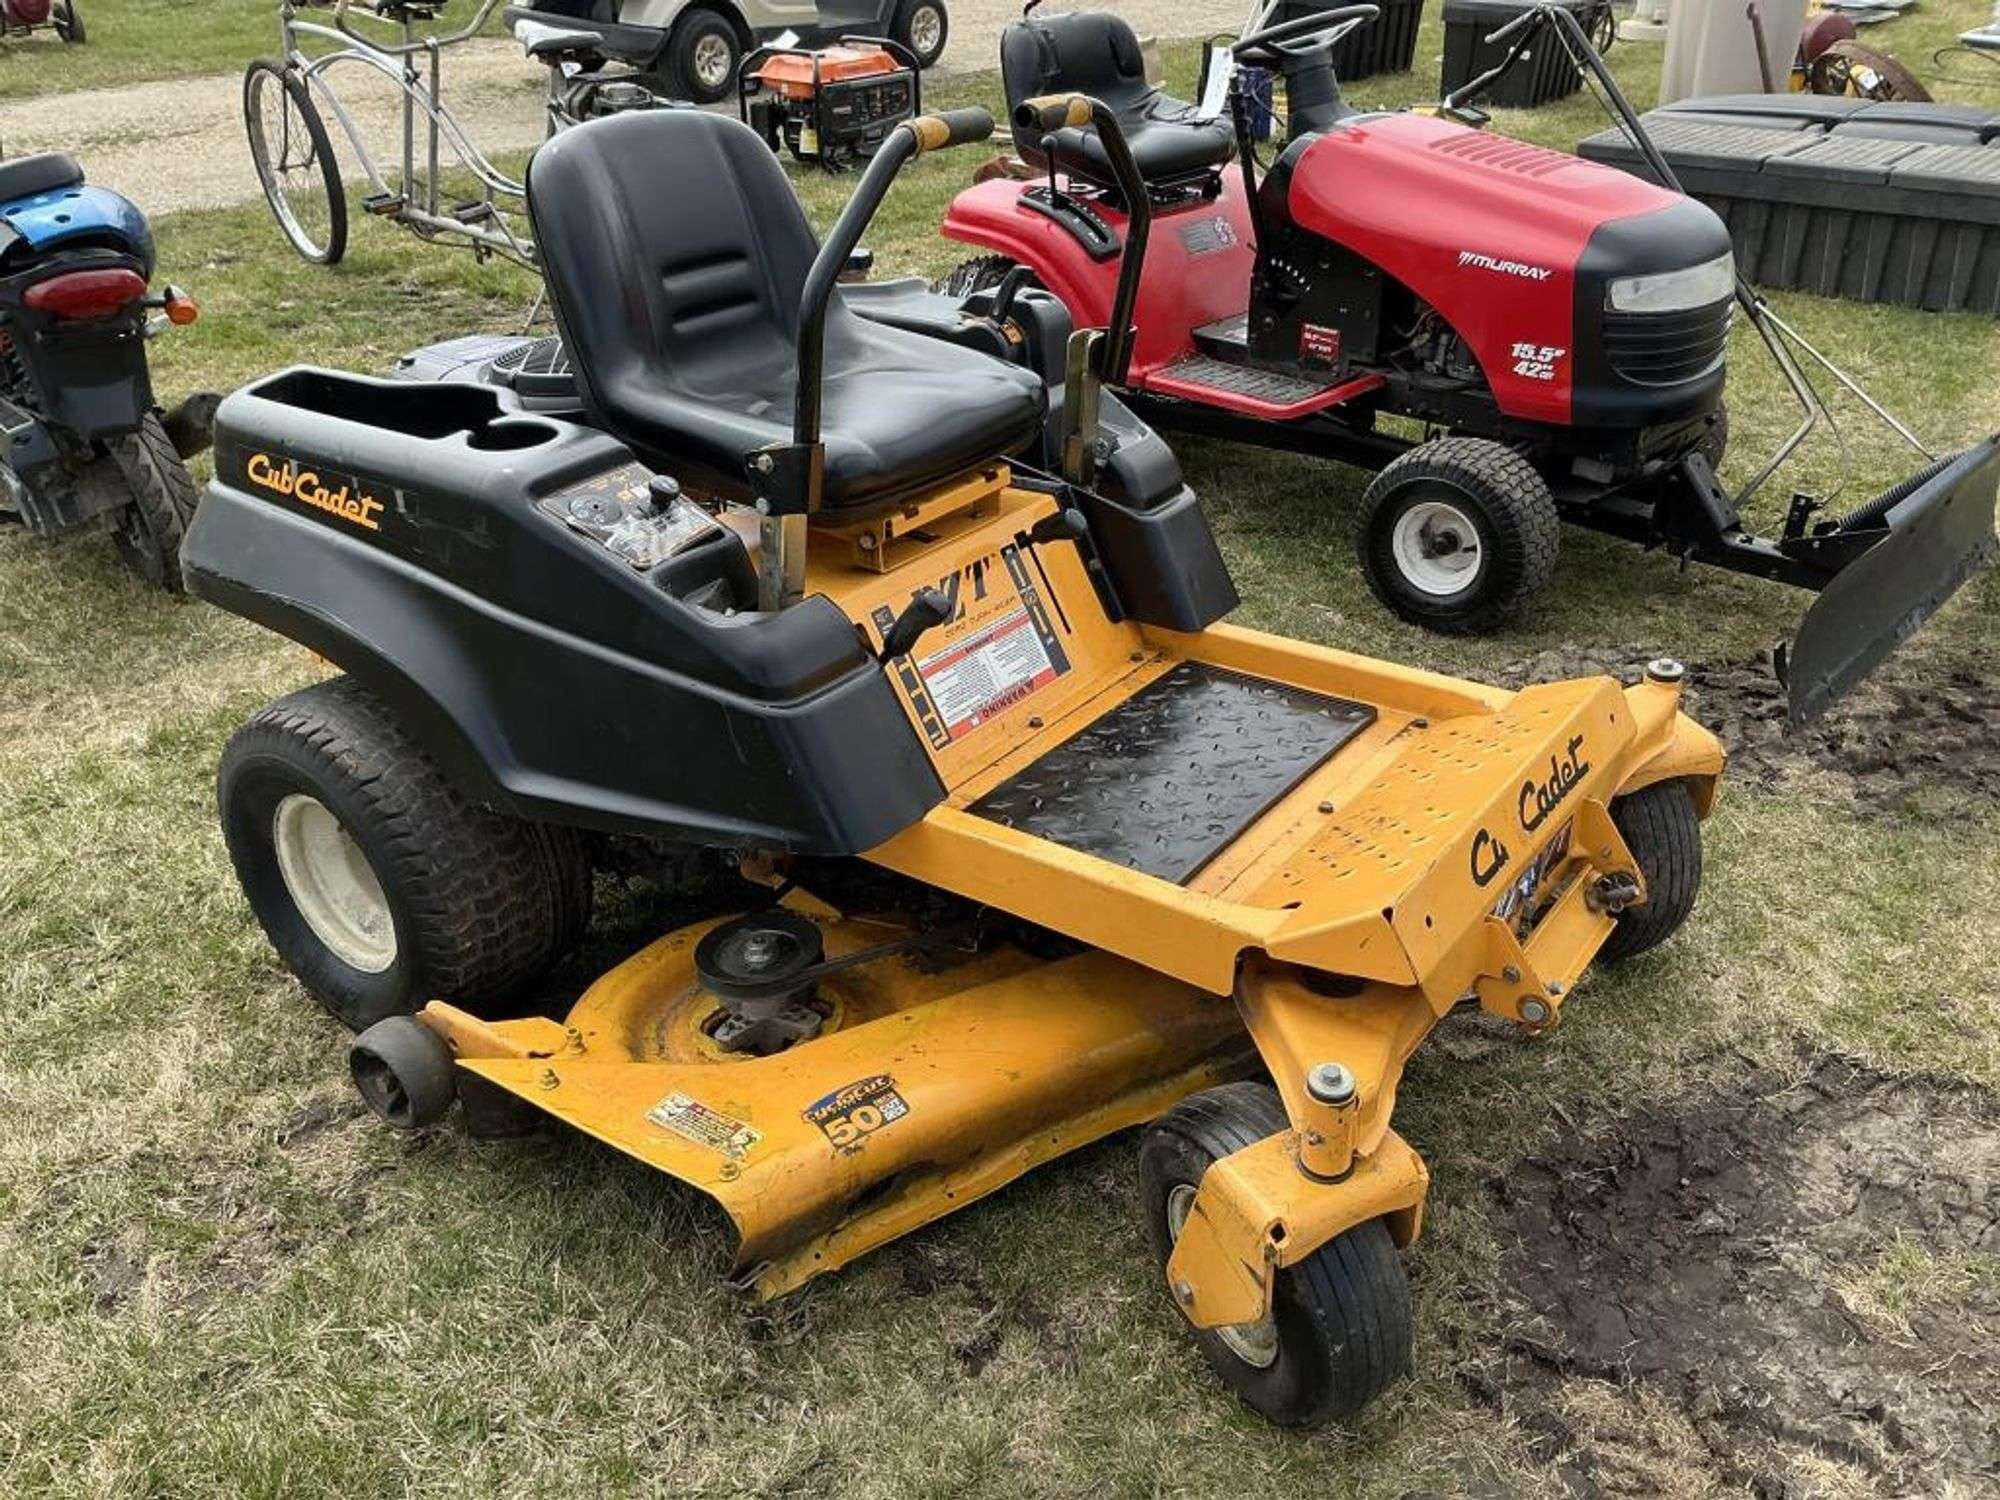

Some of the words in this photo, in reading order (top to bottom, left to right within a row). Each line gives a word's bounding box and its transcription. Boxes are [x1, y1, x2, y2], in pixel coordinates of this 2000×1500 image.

[1472, 254, 1551, 281] MURRAY
[247, 453, 293, 494] Cub
[295, 472, 384, 531] Cadet
[1519, 735, 1590, 831] Cadet
[824, 1105, 882, 1145] 50
